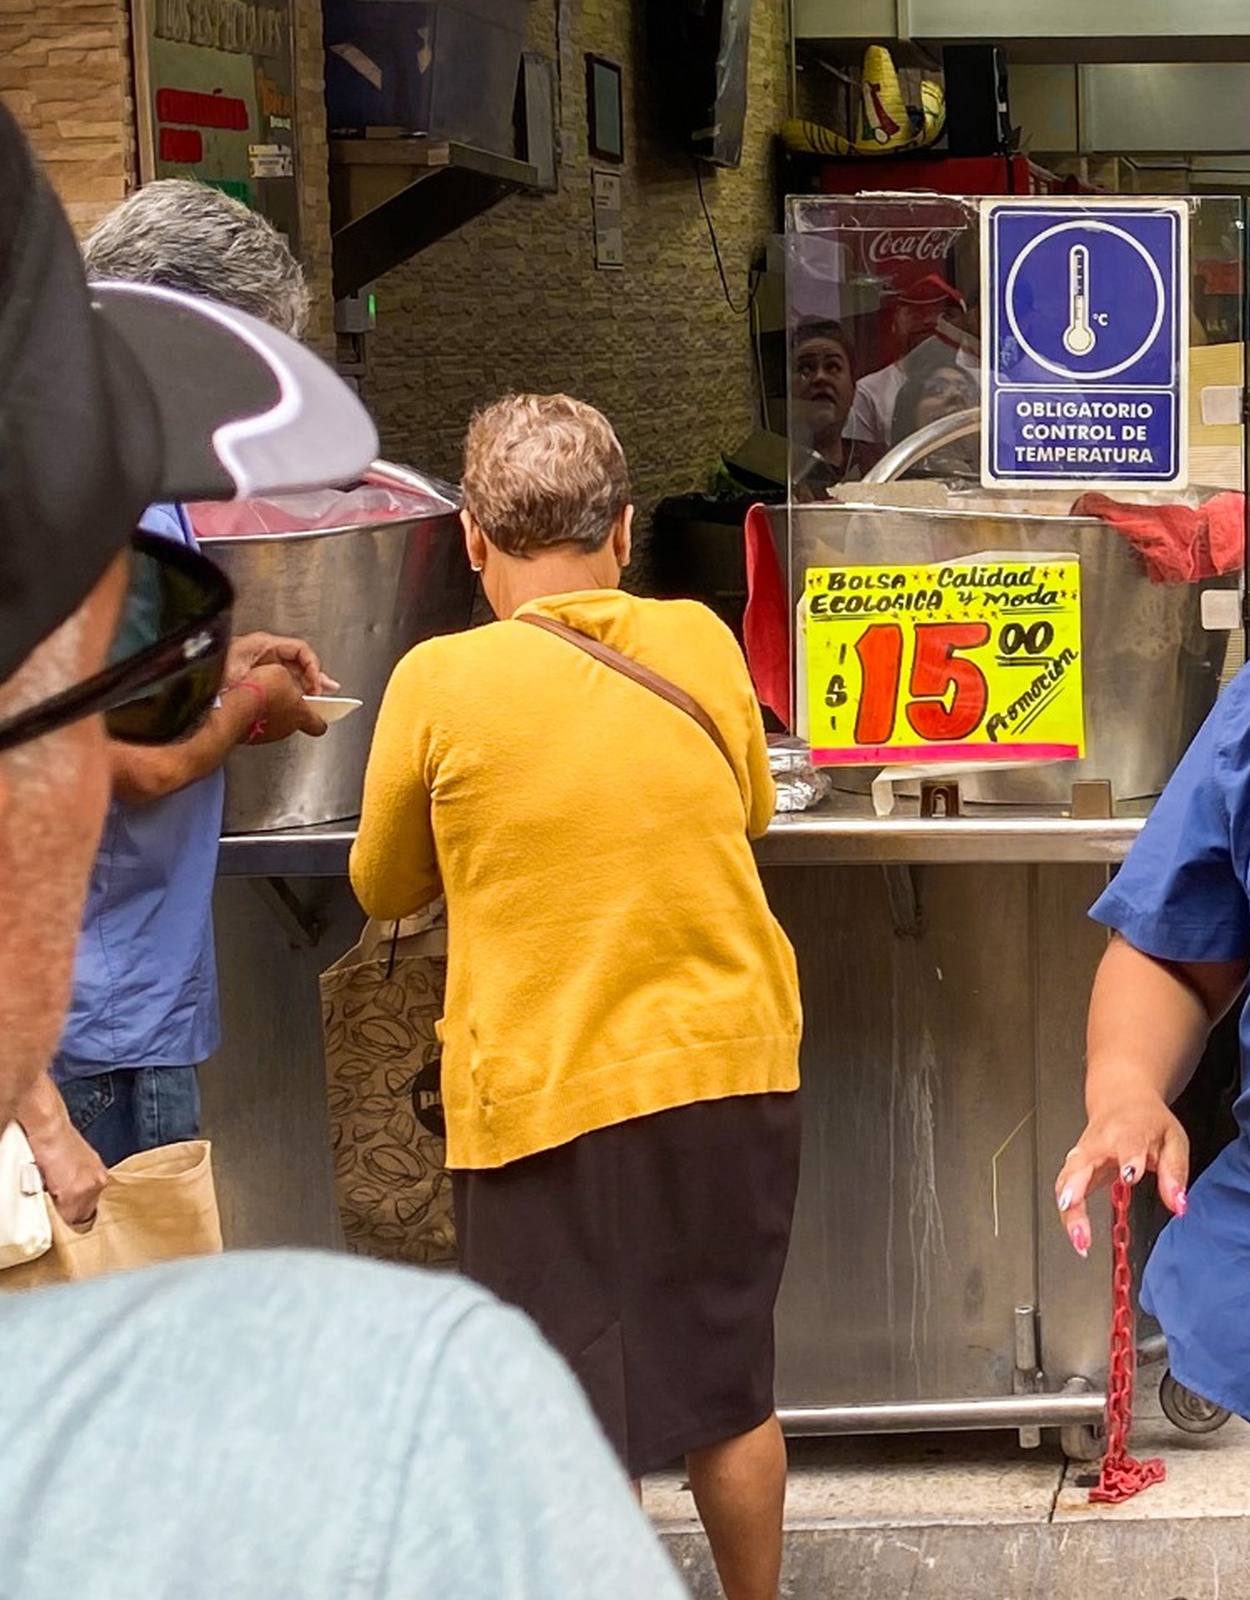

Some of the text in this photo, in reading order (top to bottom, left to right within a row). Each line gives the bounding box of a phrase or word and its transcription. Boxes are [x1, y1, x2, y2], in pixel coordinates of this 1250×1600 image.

[869, 229, 962, 262] Coca-Col
[1016, 402, 1153, 418] OBLIGATORIO
[1022, 424, 1147, 440] CONTROL DE
[1015, 446, 1153, 463] TEMPERATURA
[828, 572, 906, 591] BOLSA
[937, 566, 1037, 588] Calidad
[809, 590, 943, 614] ECOLOGICA
[957, 583, 1060, 607] y moda
[853, 621, 992, 745] 15
[999, 621, 1055, 656] 00
